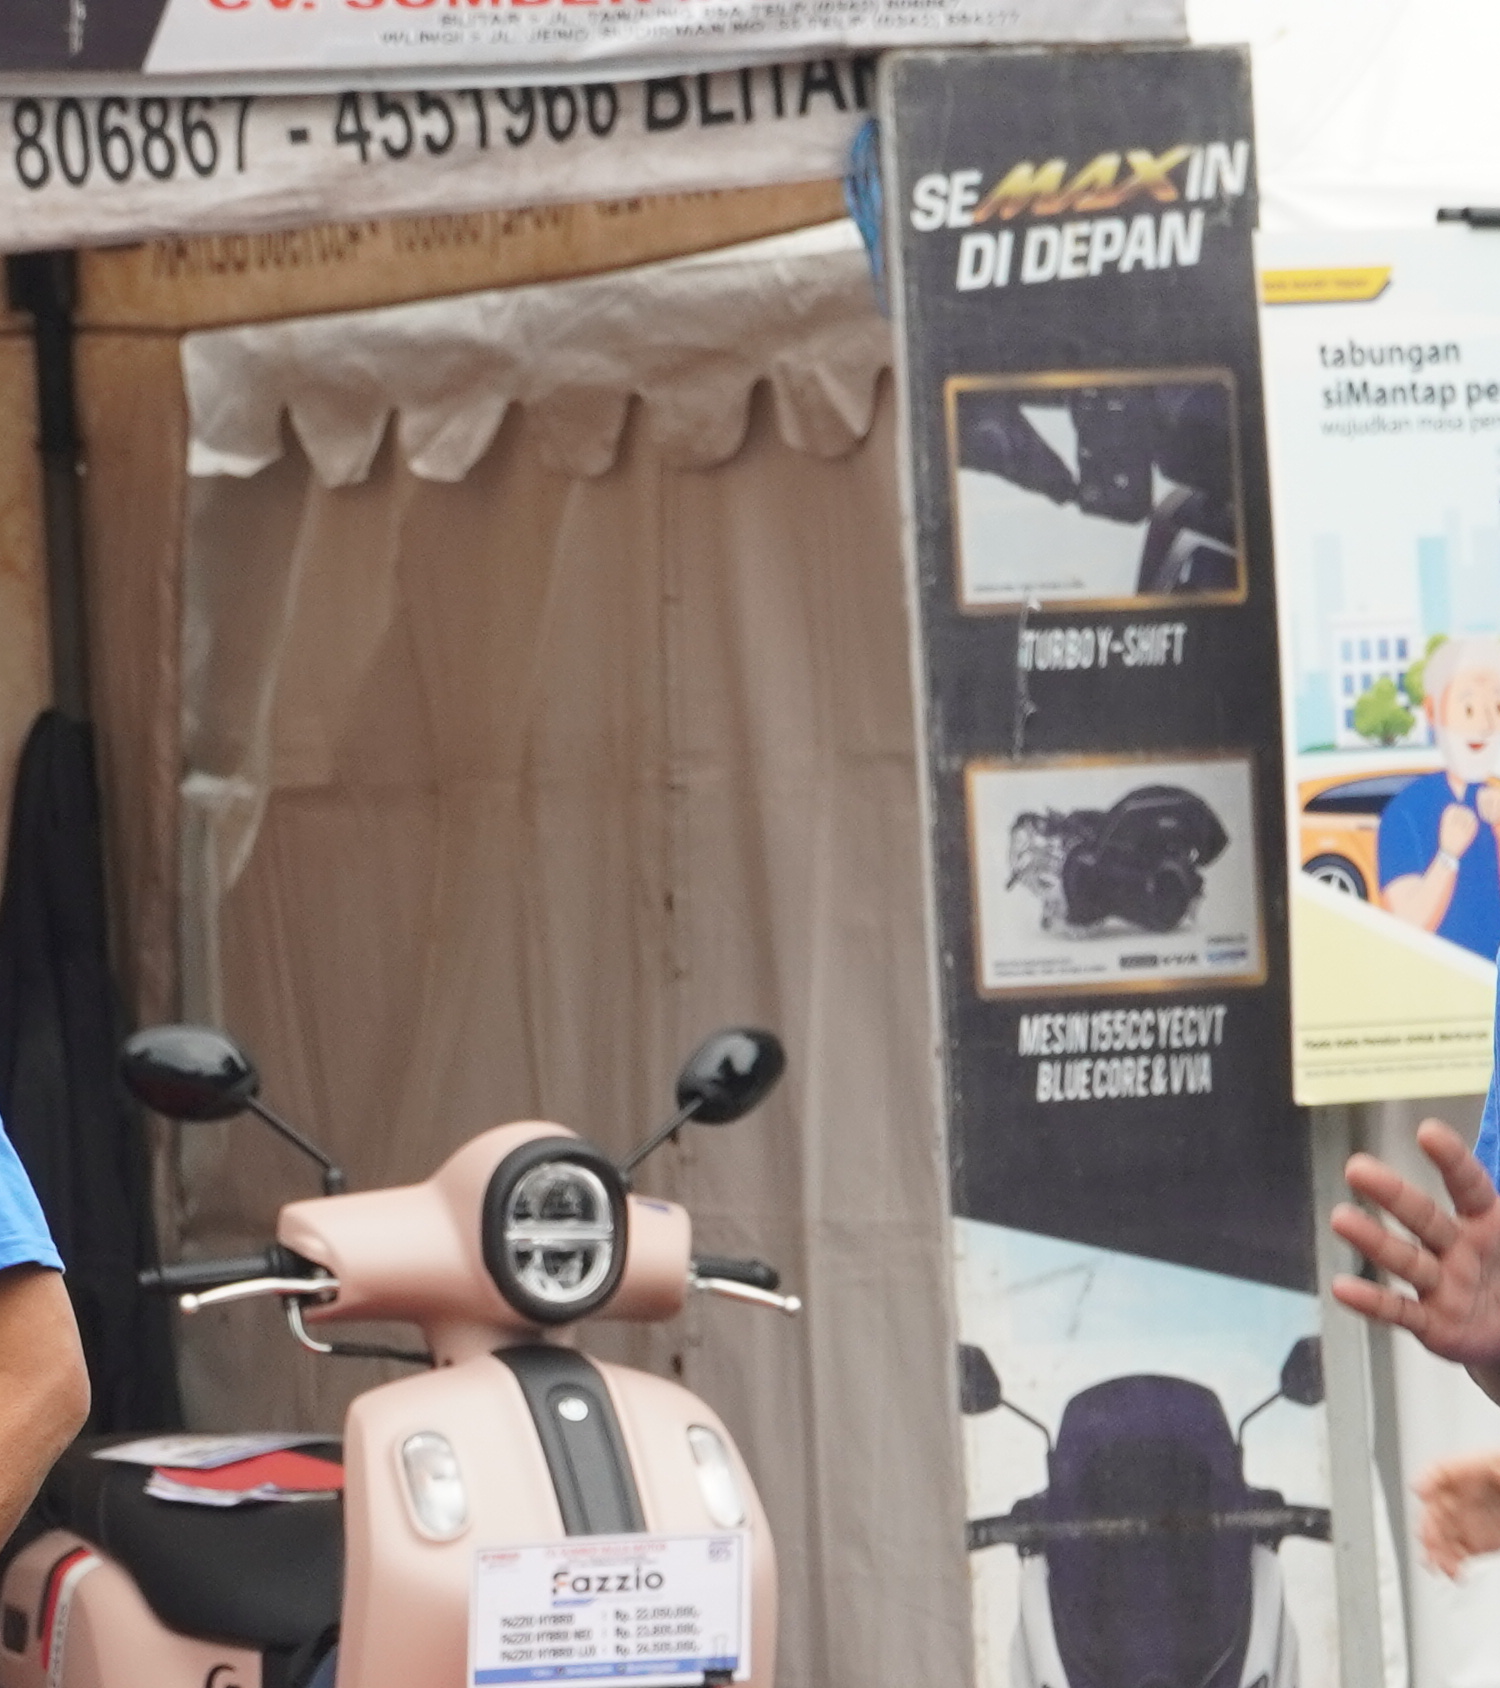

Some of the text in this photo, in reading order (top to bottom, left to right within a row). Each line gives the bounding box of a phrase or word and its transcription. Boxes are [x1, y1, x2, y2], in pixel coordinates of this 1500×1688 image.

[11, 94, 250, 190] 806867
[956, 208, 1205, 291] DI DEPAN
[1320, 338, 1460, 372] tabungan
[1322, 374, 1457, 411] siMantap
[1019, 1012, 1088, 1055] MESIN
[1037, 1057, 1096, 1101] BLUE
[1097, 1056, 1149, 1098] CORE
